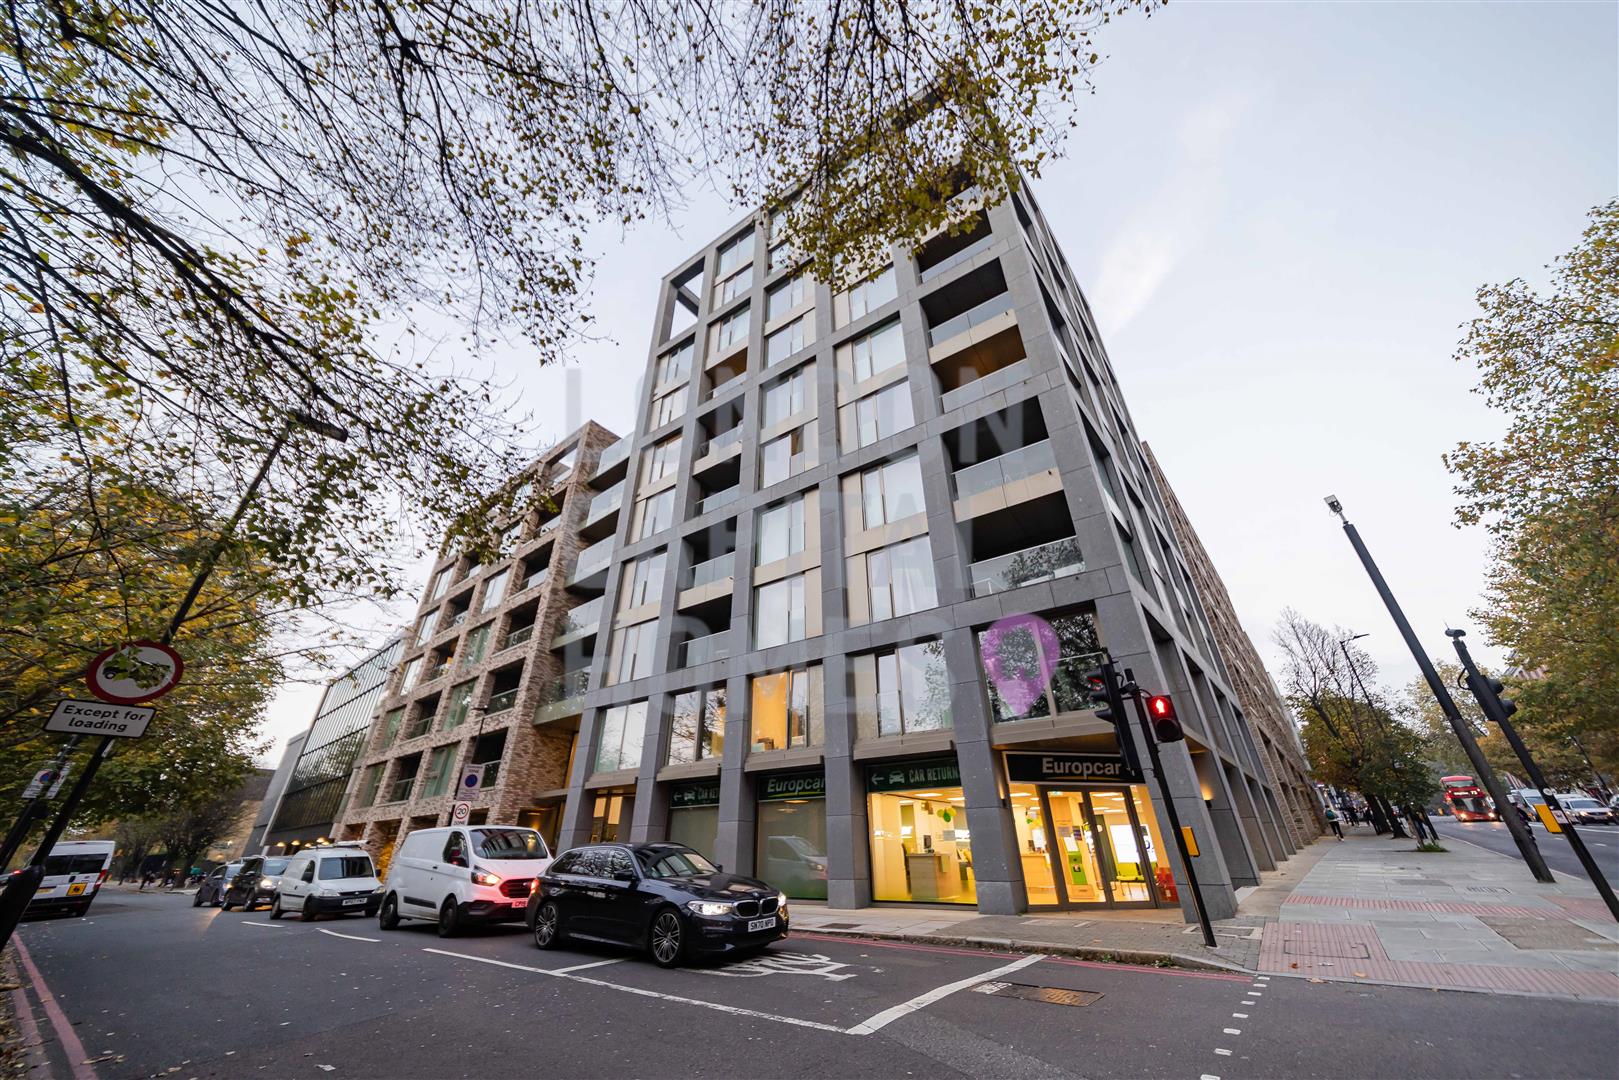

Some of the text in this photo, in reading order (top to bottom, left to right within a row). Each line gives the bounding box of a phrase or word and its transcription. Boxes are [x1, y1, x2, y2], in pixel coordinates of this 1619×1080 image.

[63, 704, 146, 721] Except for
[68, 717, 128, 733] loading
[908, 766, 959, 783] CAR RETURN
[1042, 758, 1121, 780] Europcar
[457, 807, 467, 815] 20
